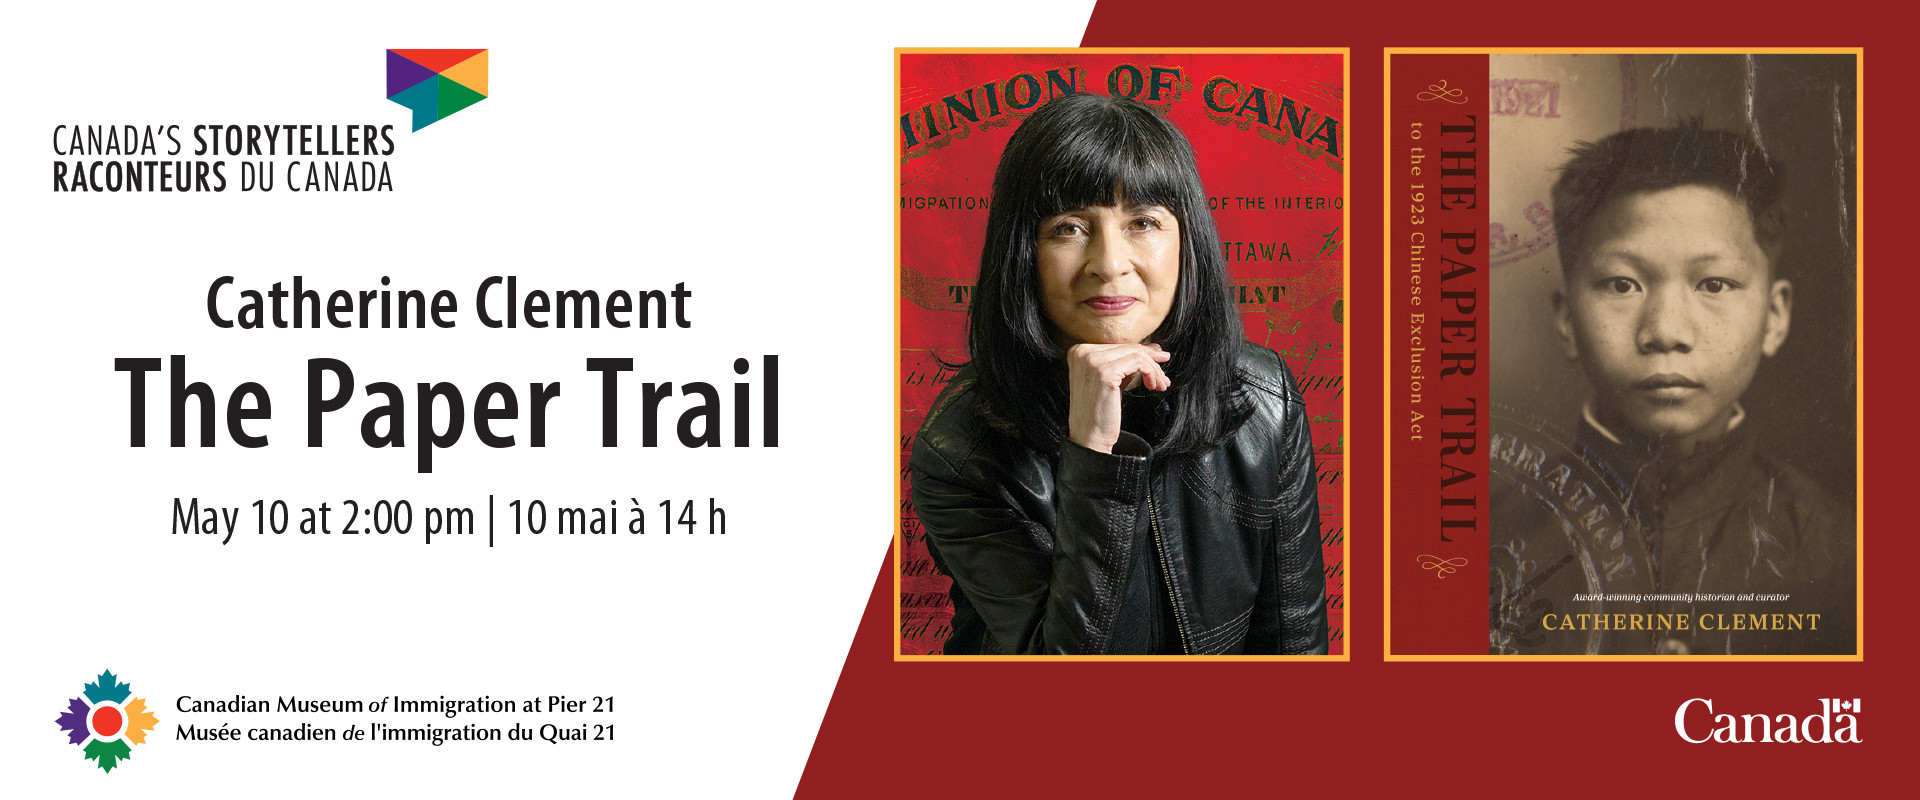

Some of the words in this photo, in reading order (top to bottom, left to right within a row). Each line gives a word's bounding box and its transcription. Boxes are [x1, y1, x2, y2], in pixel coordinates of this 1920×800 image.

[1107, 64, 1181, 101] OF
[54, 125, 181, 155] CANADA'S
[194, 124, 395, 156] STORYTELLERS
[1410, 122, 1423, 140] to
[54, 161, 227, 192] RACONTEURS
[242, 161, 274, 192] DU
[288, 161, 393, 192] CANADA
[1410, 147, 1425, 176] the
[1440, 115, 1477, 210] THE
[1208, 197, 1231, 210] OF
[1236, 197, 1266, 210] THE
[1410, 183, 1425, 225] 1923
[1410, 232, 1425, 306] Chinese
[208, 276, 458, 329] Catherine
[477, 276, 692, 329] Clement
[1440, 229, 1477, 380] PAPER
[1410, 312, 1425, 404] Exclusion
[115, 355, 271, 448] The
[308, 357, 560, 474] Paper
[587, 355, 779, 449] Trail
[1410, 410, 1425, 441] Act
[1440, 398, 1477, 542] TRAIL
[173, 499, 240, 546] May
[253, 499, 289, 535] 10
[300, 501, 331, 535] at
[343, 499, 412, 535] 2:00
[426, 508, 473, 545] pm
[510, 499, 547, 535] 10
[559, 499, 617, 535] mai
[628, 498, 645, 535] à
[660, 499, 697, 535] 14
[710, 498, 726, 535] h
[1573, 592, 1642, 603] Award-winning
[1643, 592, 1693, 603] community
[1695, 592, 1735, 602] historian
[1737, 592, 1754, 602] and
[1756, 593, 1790, 602] curator
[1542, 613, 1690, 631] CATHERINE
[1699, 613, 1821, 631] CLEMENT
[176, 695, 270, 713] Canadian
[277, 696, 362, 713] Museum
[369, 696, 389, 713] of
[395, 695, 516, 717] Immigration
[523, 697, 542, 713] at
[549, 695, 587, 713] Pier
[593, 696, 614, 713] 21
[1675, 698, 1864, 744] Canada
[176, 722, 242, 741] Musée
[248, 722, 336, 741] canadien
[343, 724, 365, 741] de
[372, 722, 501, 747] l'immigration
[508, 722, 532, 741] du
[540, 723, 587, 745] Quai
[594, 723, 614, 741] 21
